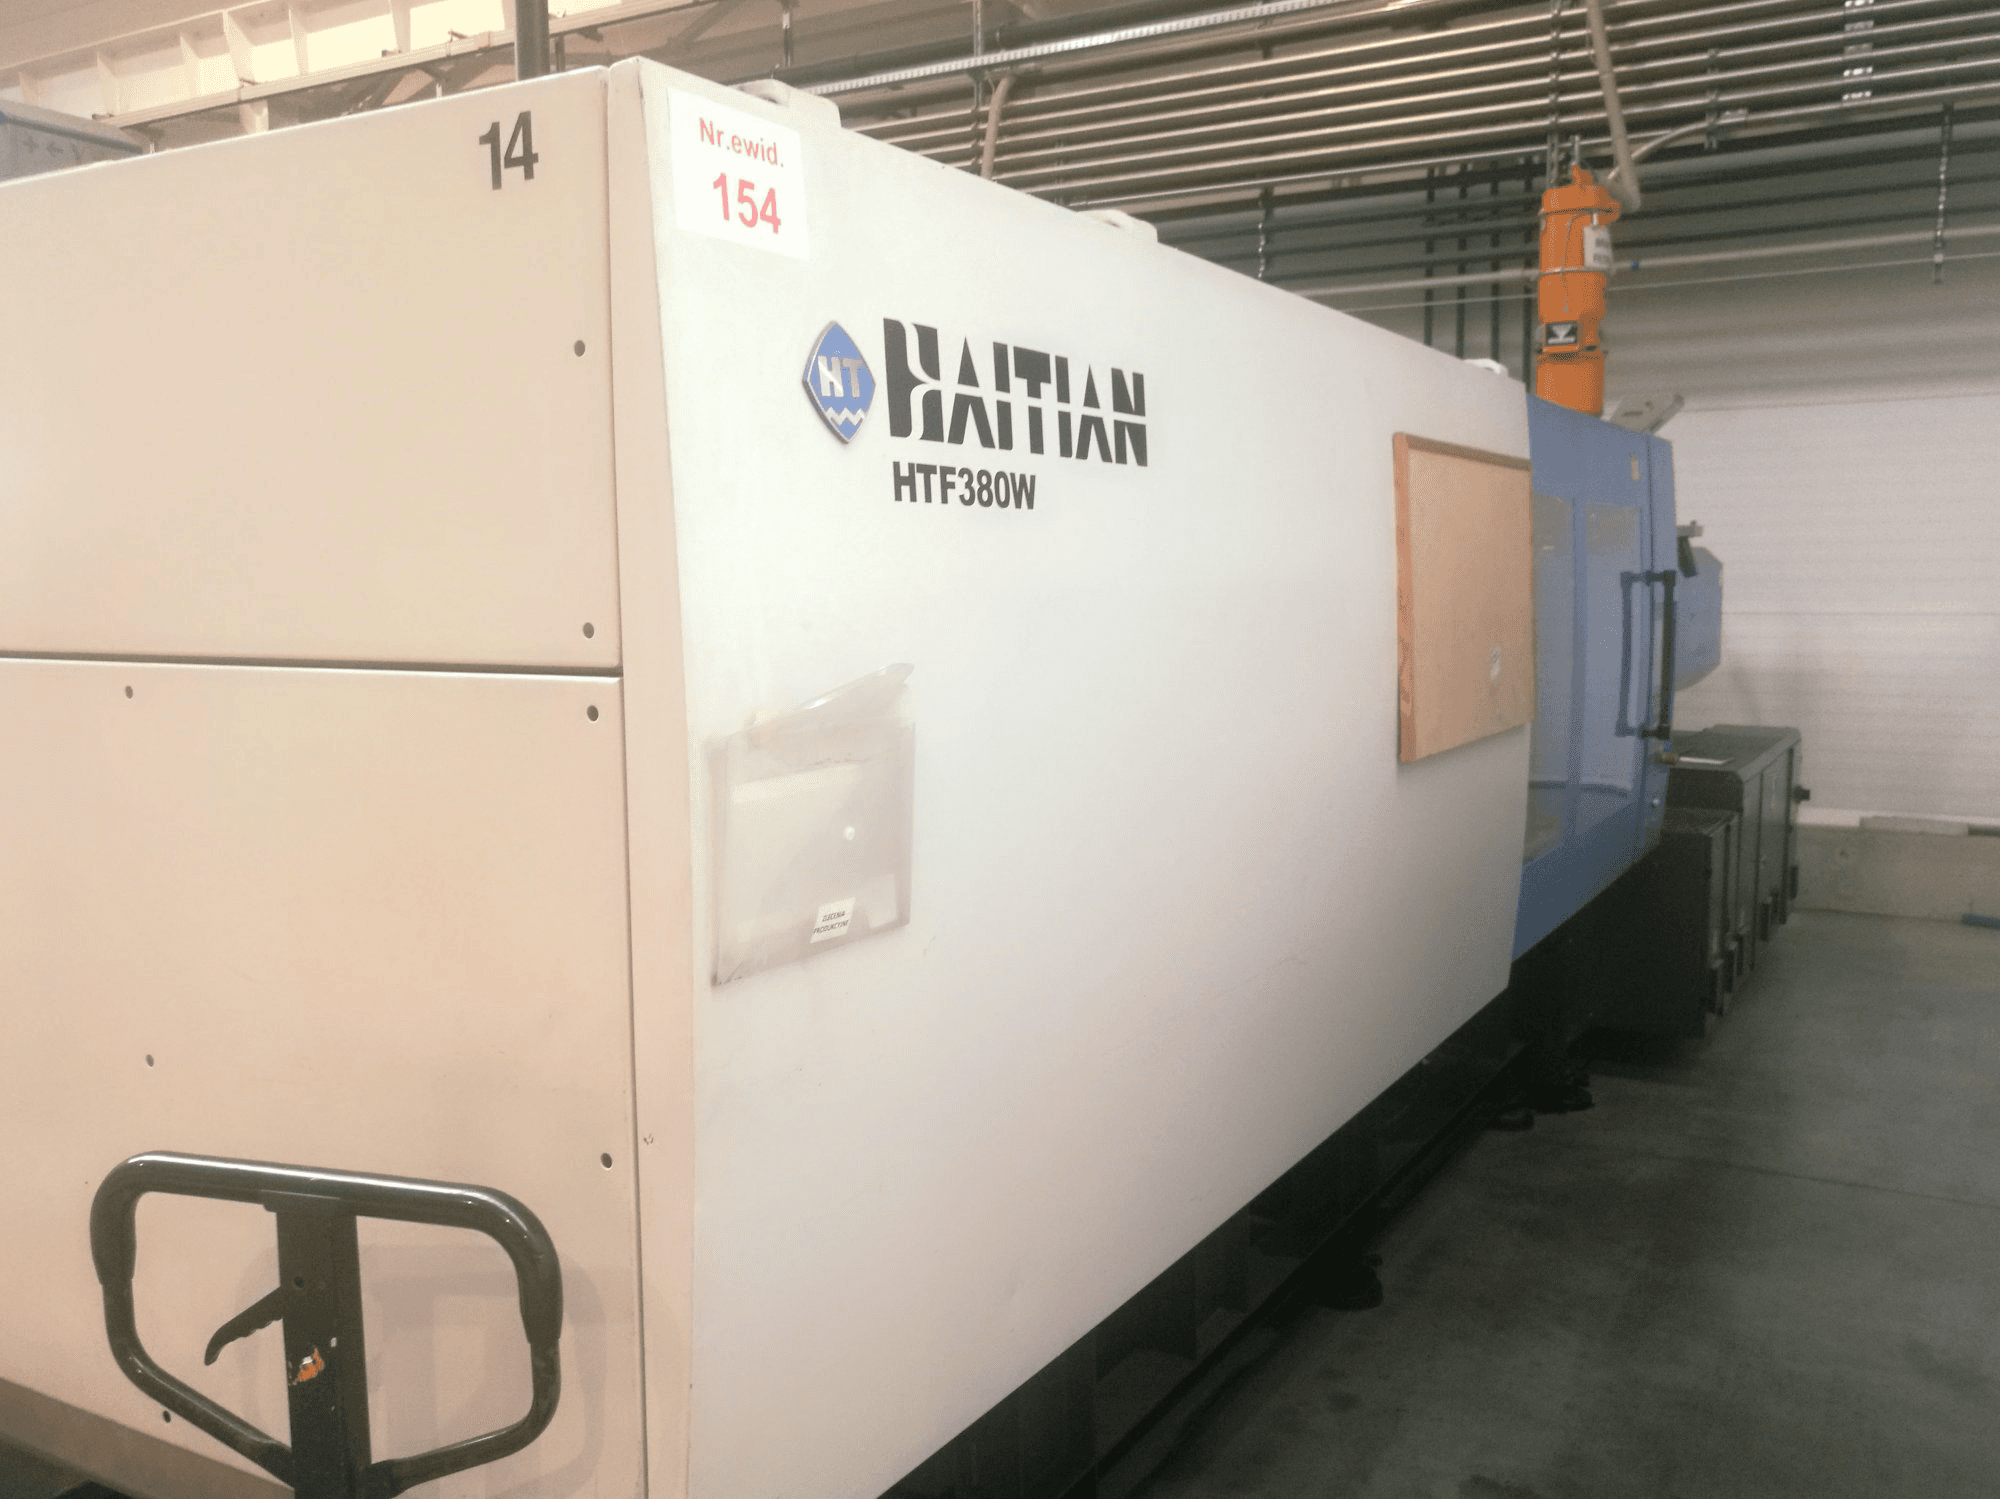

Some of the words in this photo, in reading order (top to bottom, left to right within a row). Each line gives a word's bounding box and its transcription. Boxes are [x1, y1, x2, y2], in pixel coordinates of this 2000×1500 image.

[479, 110, 539, 190] 14
[699, 117, 784, 168] Nr.ewid.
[713, 172, 781, 234] 154
[817, 355, 862, 398] HT
[883, 318, 1148, 467] HAITIAN
[893, 461, 1036, 510] HTF380W
